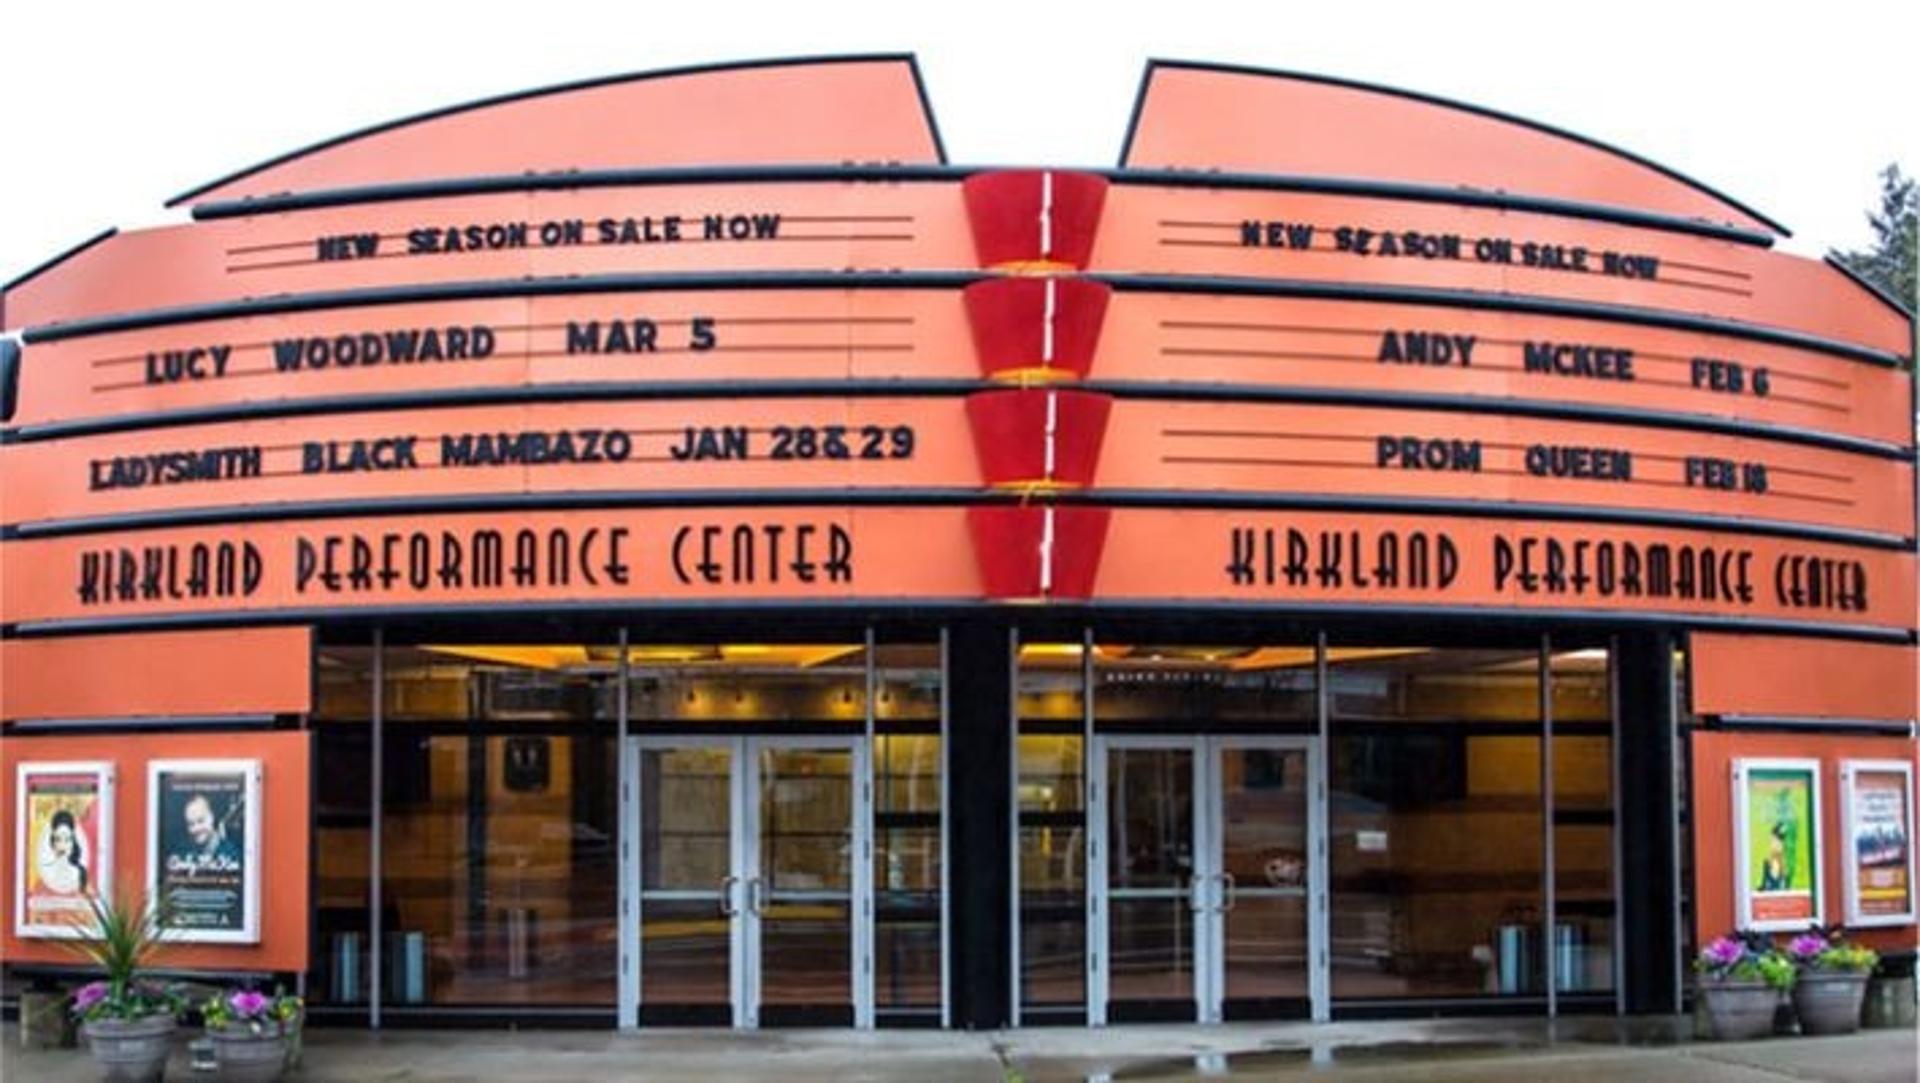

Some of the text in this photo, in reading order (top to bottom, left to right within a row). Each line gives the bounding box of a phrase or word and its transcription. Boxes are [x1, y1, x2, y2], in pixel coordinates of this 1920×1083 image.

[317, 215, 781, 262] NEW SEASON ON SALE NOW
[1240, 221, 1660, 281] NEW SEASON ON SALE NOW
[146, 318, 716, 385] LUCY WOODWARD MAR 5
[1377, 330, 1769, 398] ANDY MCKEE FEB 6
[90, 446, 262, 491] LADYSMITH
[302, 436, 418, 475] BLACK
[441, 430, 632, 467] MAMBAZO
[670, 427, 749, 461] JAN
[1377, 435, 1768, 495] PROM QUEEN FEB 18
[77, 524, 852, 604] KIRKLAND PERFORMANCE CENTER
[1226, 528, 1867, 613] KIRKLAND PERFORMANCE CENTER
